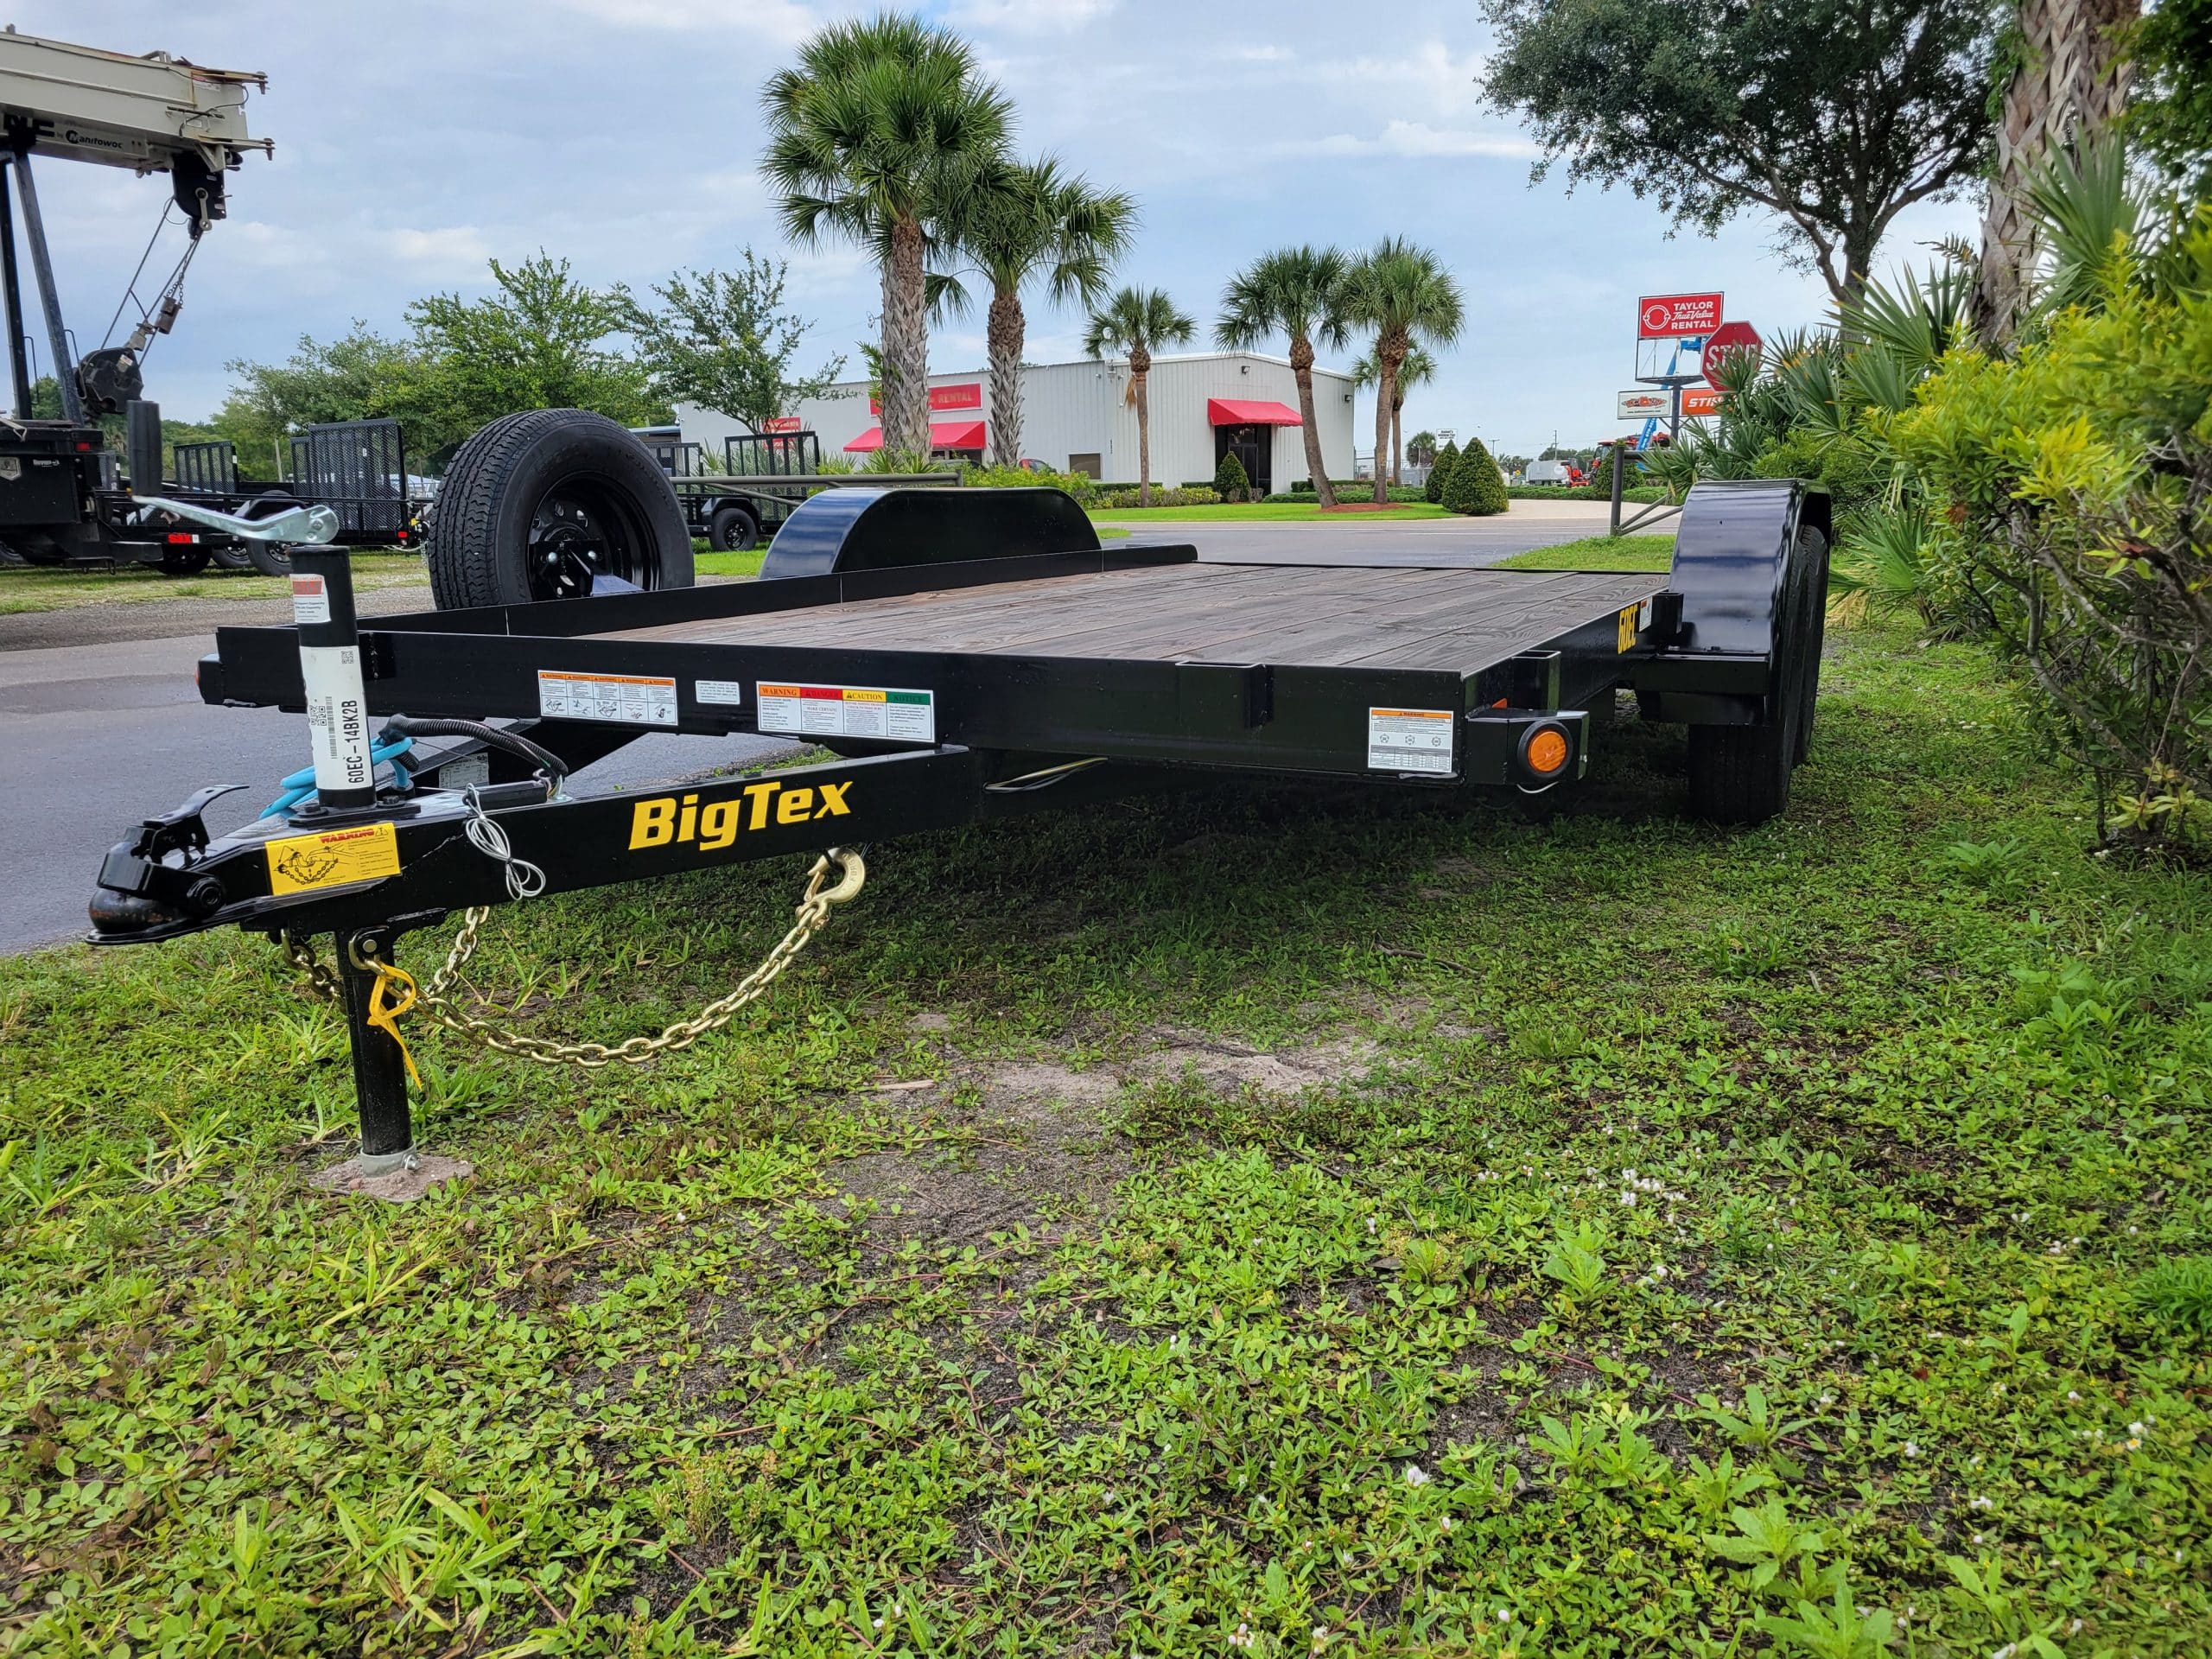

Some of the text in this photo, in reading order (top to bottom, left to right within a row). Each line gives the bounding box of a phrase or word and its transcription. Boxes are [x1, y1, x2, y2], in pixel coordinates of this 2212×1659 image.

[1673, 301, 1714, 312] TAYLOR
[762, 687, 797, 696] WARNING
[320, 829, 374, 843] WARNING
